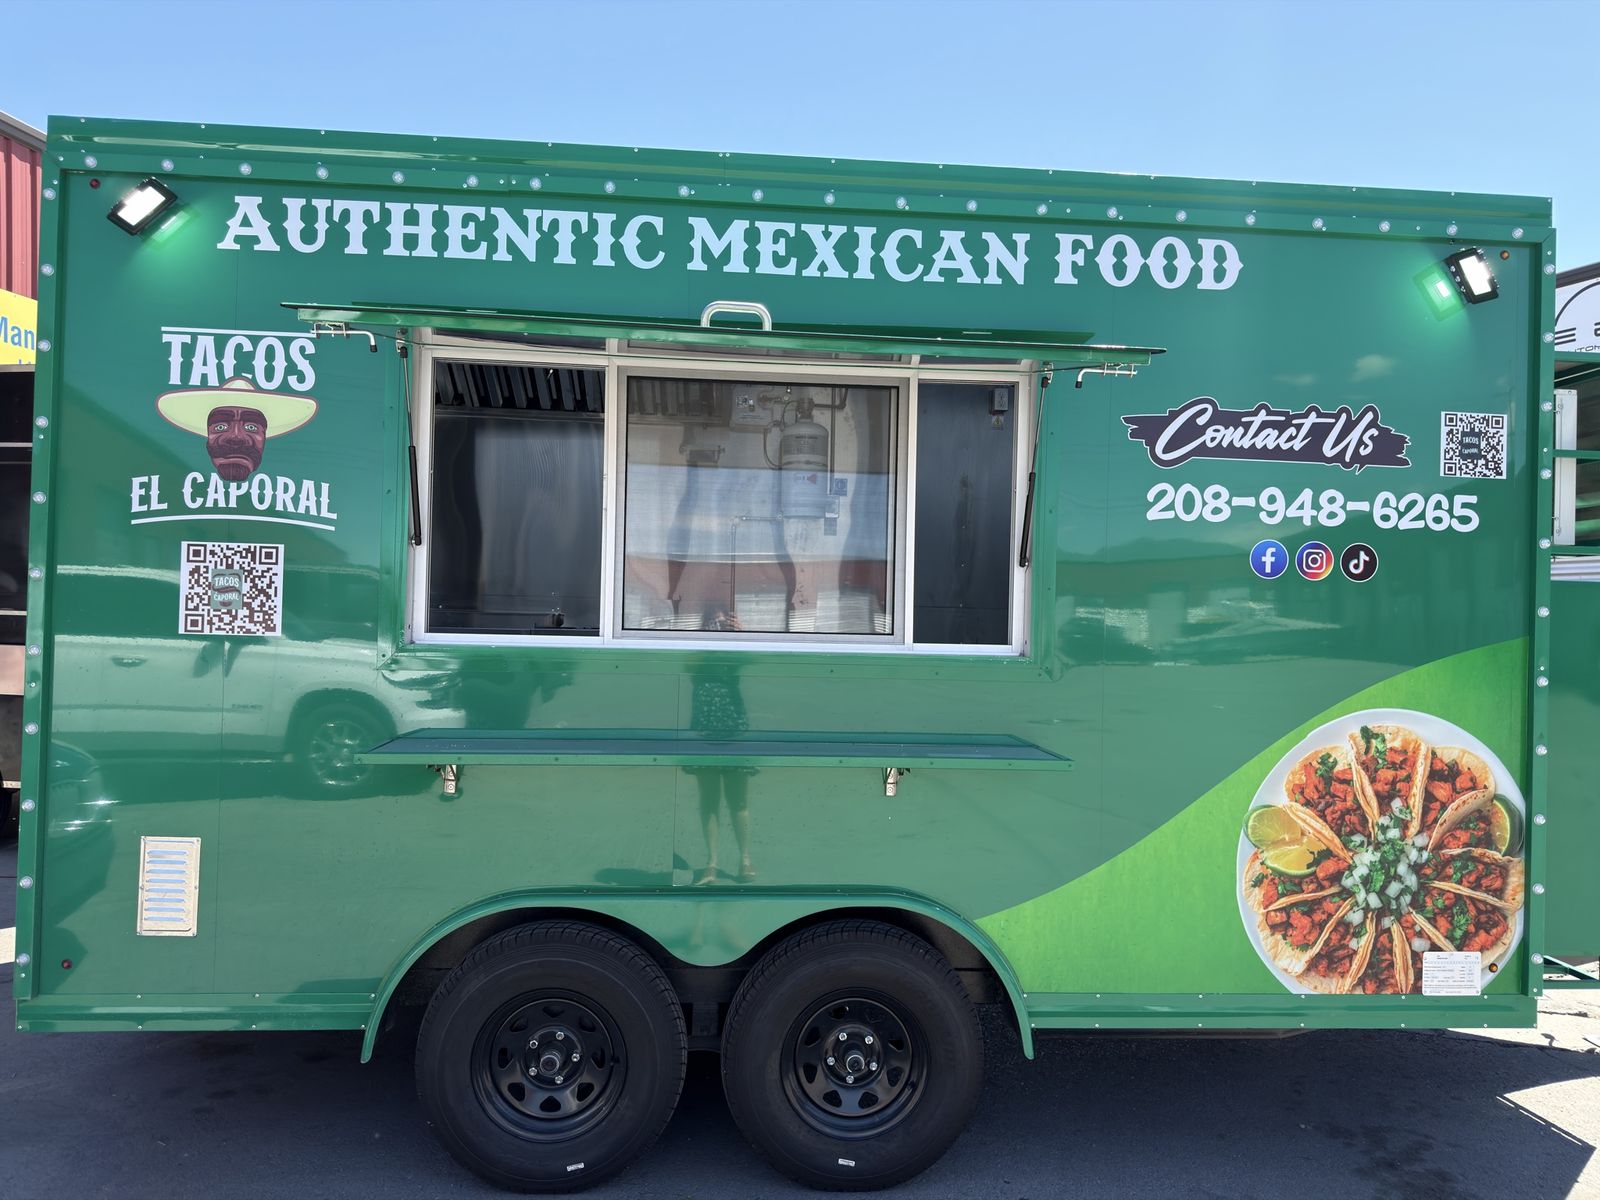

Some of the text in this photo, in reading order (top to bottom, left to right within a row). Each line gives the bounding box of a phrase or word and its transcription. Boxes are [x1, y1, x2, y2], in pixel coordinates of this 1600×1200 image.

[217, 195, 1245, 290] AUTHENTIC MEXICAN FOOD
[161, 333, 316, 391] TACOS
[1155, 403, 1379, 462] Contact Us
[1463, 436, 1479, 444] TACOS
[130, 471, 337, 520] EL CAPORAL
[1146, 482, 1480, 533] 208-948-6265
[213, 593, 239, 601] CAPORAL
[214, 577, 240, 587] TACOS
